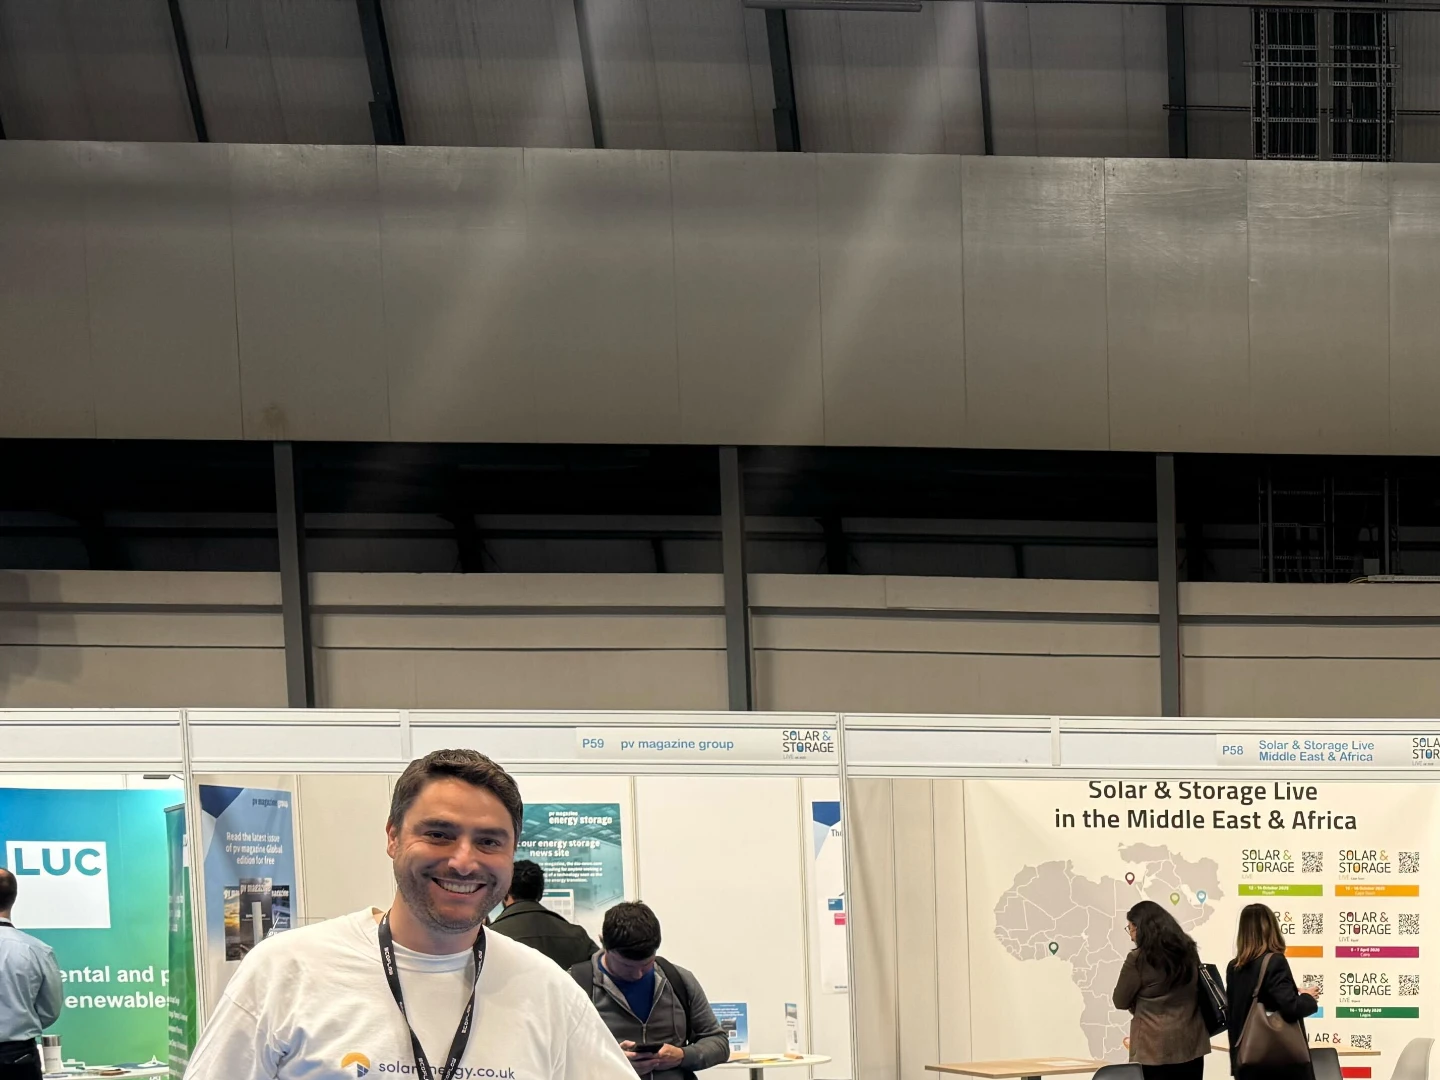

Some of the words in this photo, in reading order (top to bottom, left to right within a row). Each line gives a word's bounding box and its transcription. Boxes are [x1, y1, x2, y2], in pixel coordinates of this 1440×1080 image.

[782, 730, 820, 741] SOLAR
[822, 730, 831, 741] &
[582, 738, 604, 749] P59
[621, 740, 634, 750] pv
[638, 738, 695, 751] magazine
[698, 740, 734, 751] group
[782, 742, 834, 753] STORAGE
[1222, 746, 1244, 755] P58
[1259, 740, 1290, 750] Solar
[1293, 740, 1300, 750] &
[1304, 740, 1348, 752] Storage
[1352, 741, 1374, 750] Live
[1259, 751, 1296, 762] Middle
[1300, 752, 1324, 762] East
[1328, 752, 1336, 762] &
[1339, 752, 1373, 762] Africa
[1088, 780, 1148, 799] Solar
[1154, 781, 1172, 799] &
[1178, 781, 1266, 806] Storage
[1274, 782, 1318, 800] Live
[548, 816, 578, 826] energy
[580, 816, 612, 826] storage
[1055, 808, 1075, 828] in
[1082, 809, 1120, 828] the
[1127, 809, 1205, 830] Middle
[1212, 810, 1262, 830] East
[1268, 811, 1285, 830] &
[1292, 810, 1357, 830] Africa
[226, 832, 242, 841] Read
[242, 832, 251, 842] the
[242, 844, 266, 855] magazine
[538, 841, 567, 850] energy
[568, 840, 600, 849] storage
[554, 849, 570, 857] site
[1242, 850, 1279, 861] SOLAR
[1283, 850, 1292, 860] &
[1339, 850, 1376, 861] SOLAR
[1380, 850, 1388, 861] &
[14, 848, 102, 876] LUC
[237, 856, 255, 865] edition
[1242, 862, 1294, 873] STORAGE
[1339, 862, 1391, 873] STORAGE
[1340, 912, 1377, 923] SOLAR
[1380, 912, 1388, 922] &
[1339, 924, 1391, 935] STORAGE
[60, 966, 110, 983] ental
[117, 966, 154, 982] and
[1340, 973, 1377, 984] SOLAR
[1340, 985, 1391, 996] STORAGE
[65, 992, 169, 1008] enewable
[379, 1060, 515, 1080] solarnegy.co.uk
